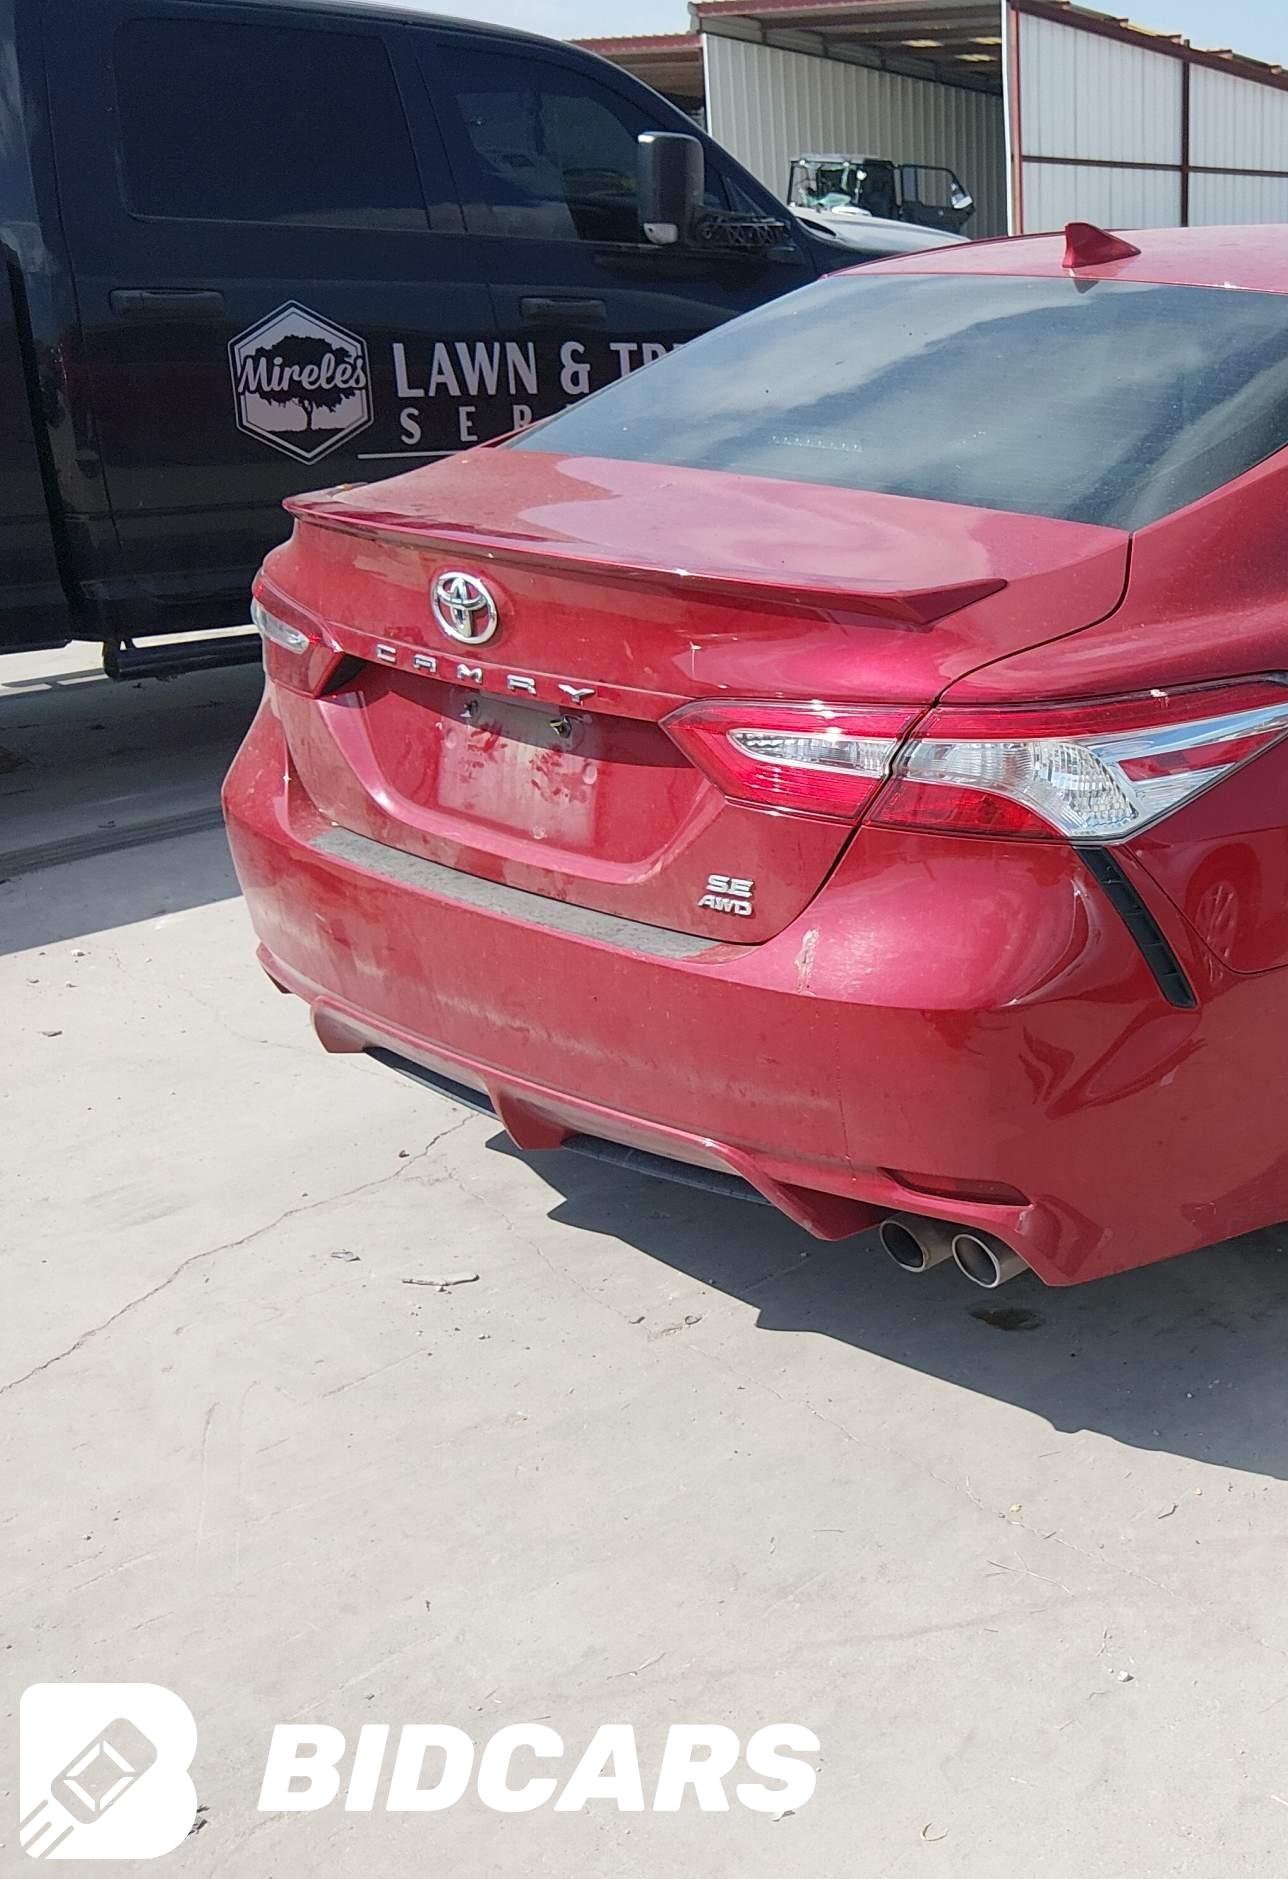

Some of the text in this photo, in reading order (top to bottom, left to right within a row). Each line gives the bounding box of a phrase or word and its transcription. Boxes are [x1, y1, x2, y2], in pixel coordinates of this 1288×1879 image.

[238, 353, 367, 392] Mireles
[393, 342, 538, 397] LAWN
[560, 341, 591, 394] &
[400, 403, 574, 445] SER
[376, 644, 595, 706] CAMRY
[697, 894, 752, 916] AWD
[706, 874, 754, 898] SE
